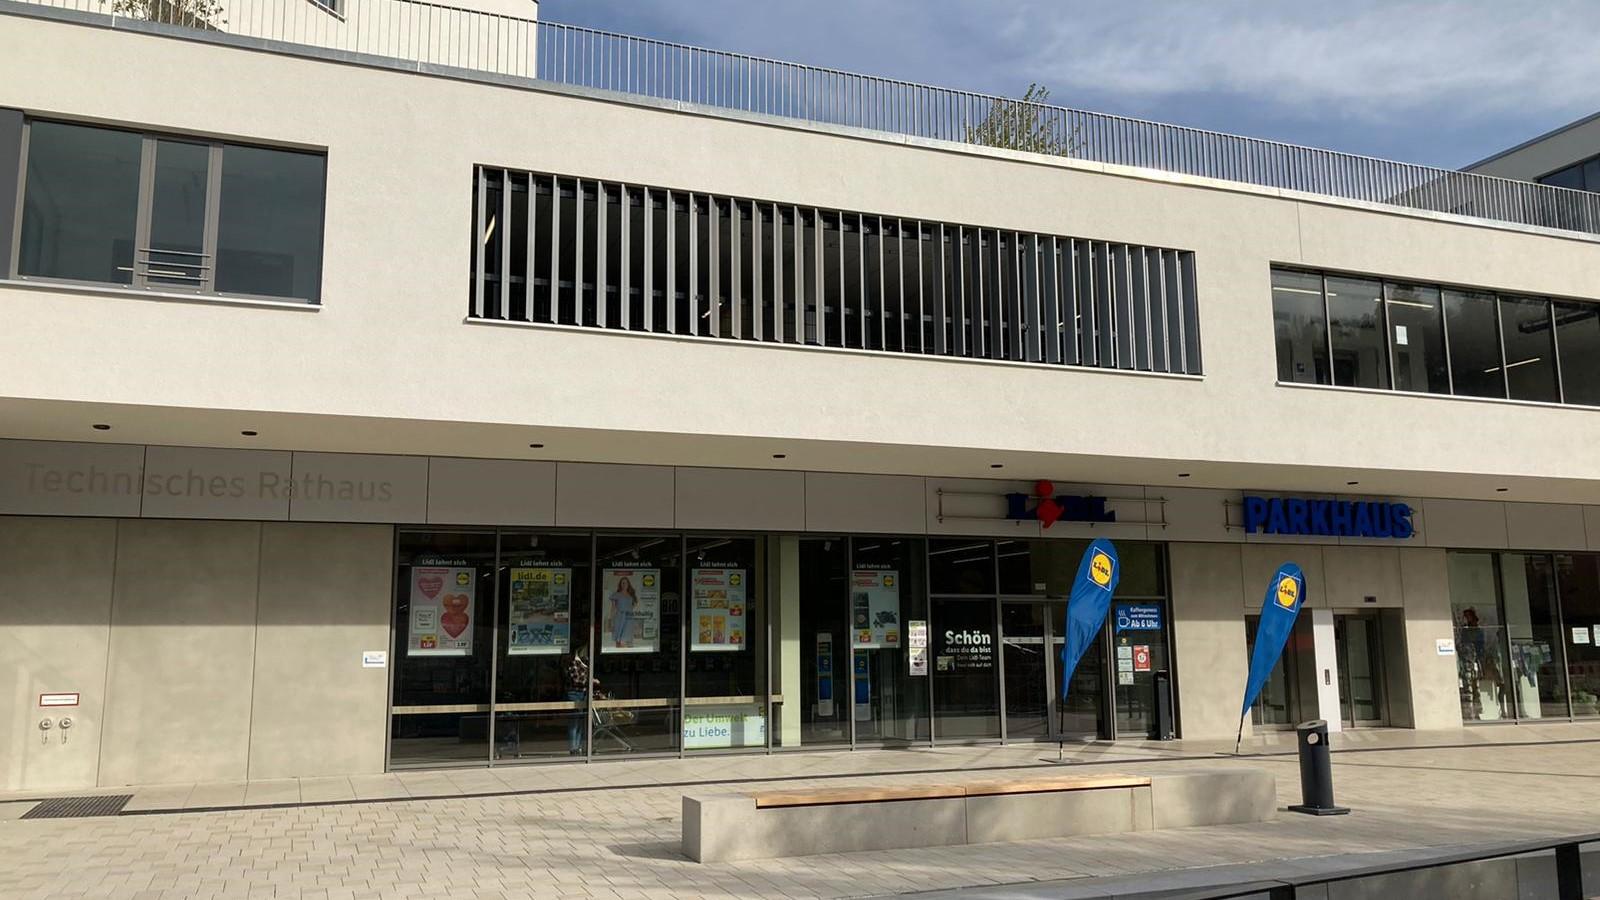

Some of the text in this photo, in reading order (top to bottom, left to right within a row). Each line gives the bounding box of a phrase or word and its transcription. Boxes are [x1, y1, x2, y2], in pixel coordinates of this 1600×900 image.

[25, 462, 393, 502] Technisches Rathaus
[1243, 496, 1413, 538] PARKHAUS
[1131, 620, 1159, 628] Ab 6 Uhr
[945, 630, 991, 645] Schön
[684, 713, 703, 724] Der
[684, 727, 730, 738] zu Liebe.
